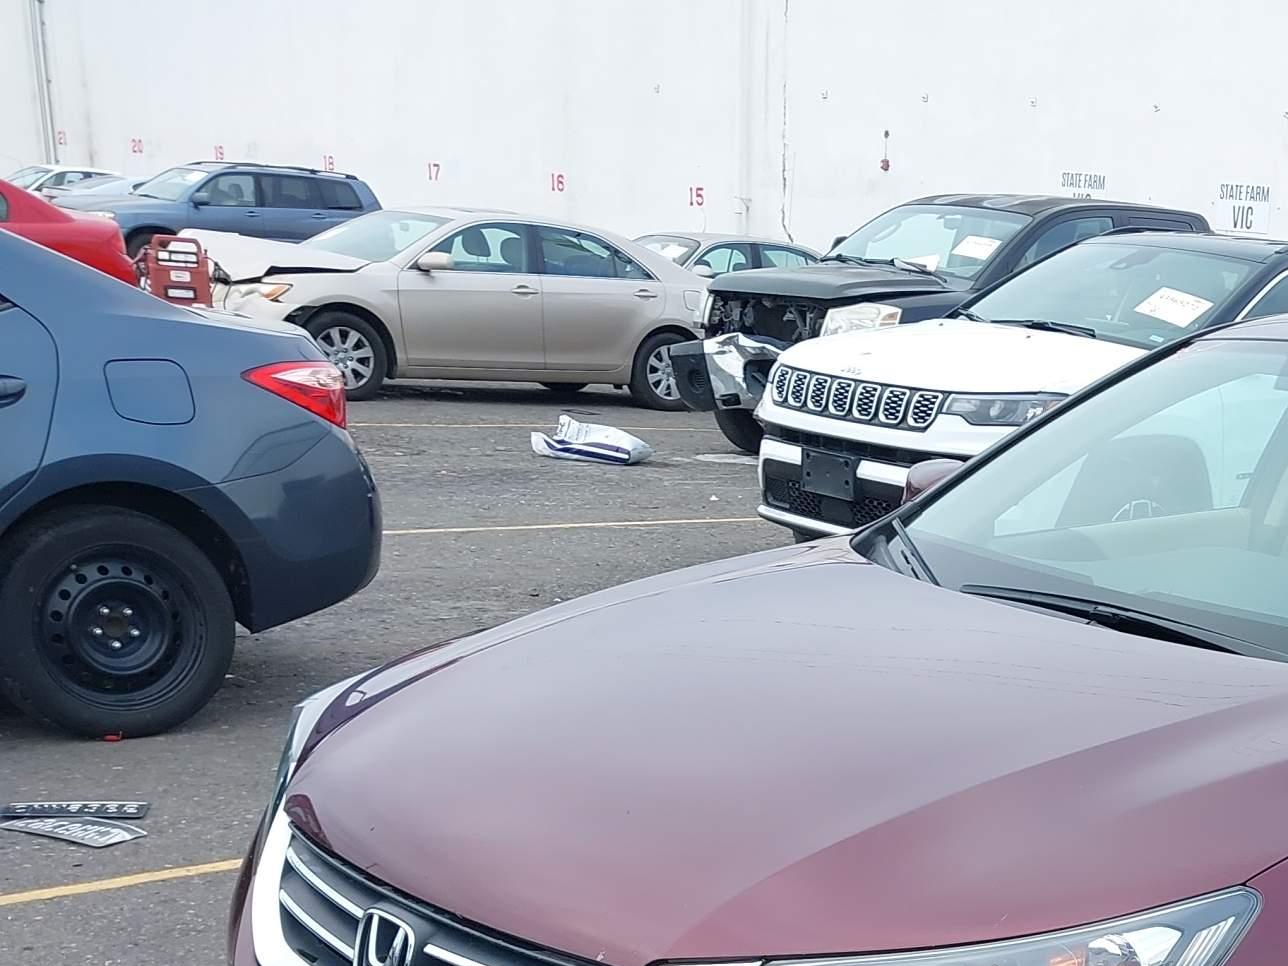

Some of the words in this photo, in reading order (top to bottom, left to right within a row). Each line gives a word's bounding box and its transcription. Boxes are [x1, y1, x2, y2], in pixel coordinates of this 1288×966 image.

[323, 155, 335, 171] 18
[428, 163, 441, 181] 17
[551, 173, 565, 192] 16
[1061, 172, 1083, 190] STATE
[1083, 174, 1105, 190] FARM
[689, 187, 705, 207] 15
[1220, 183, 1244, 201] STATE
[1245, 185, 1270, 203] FARM
[1232, 205, 1253, 230] VIC
